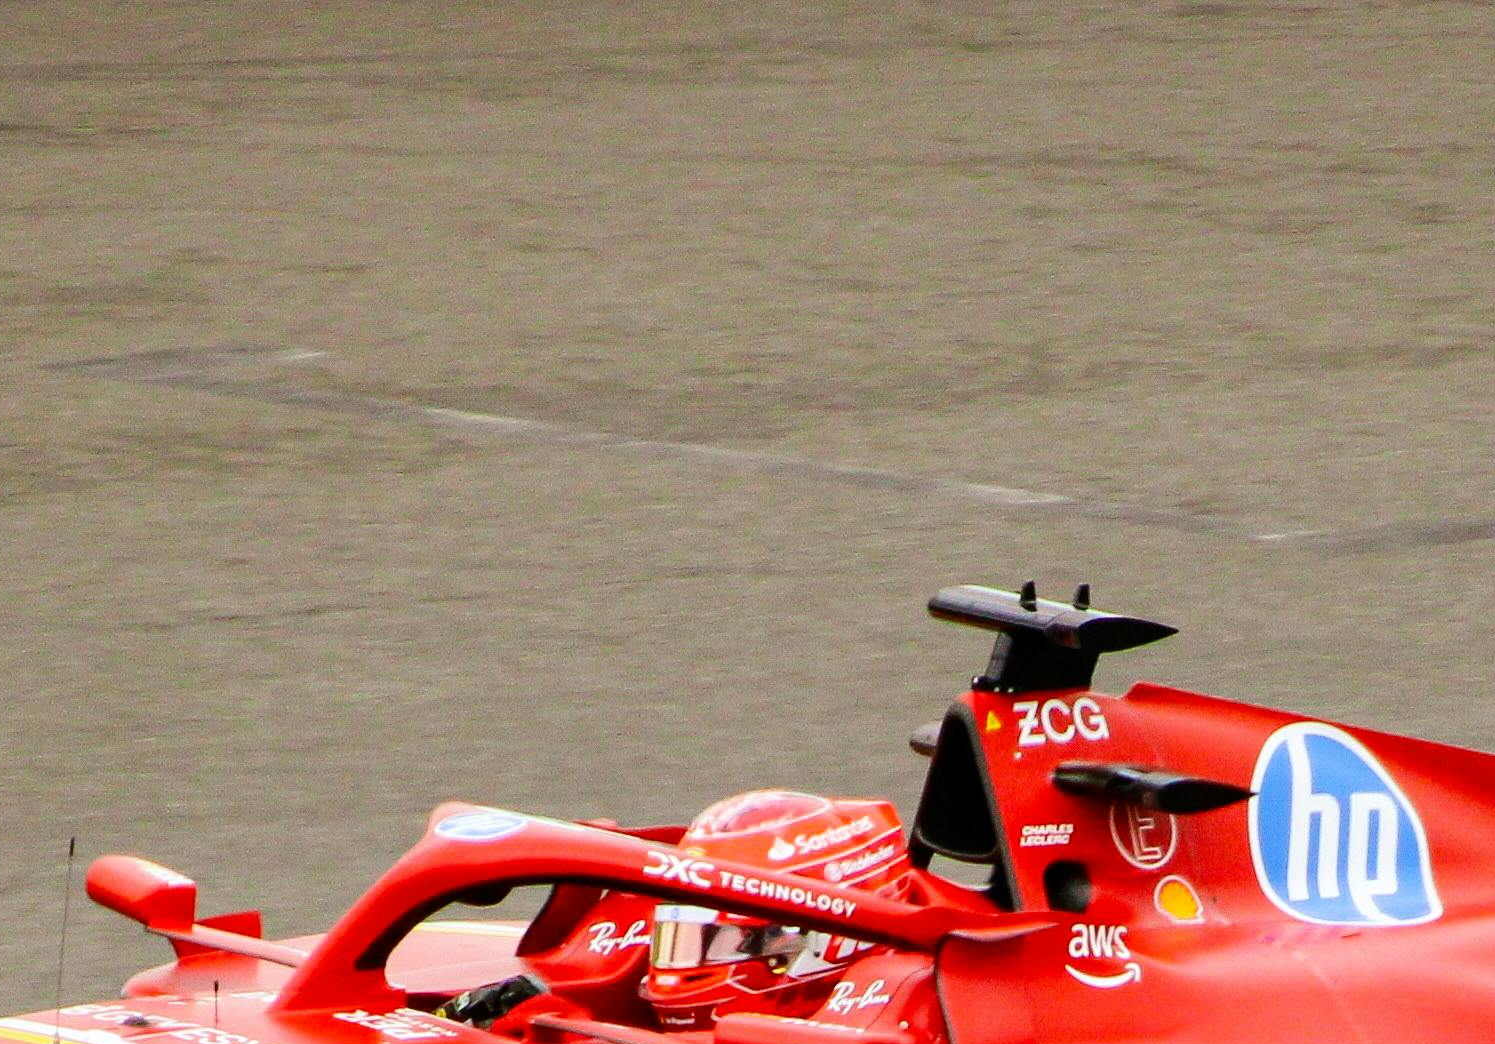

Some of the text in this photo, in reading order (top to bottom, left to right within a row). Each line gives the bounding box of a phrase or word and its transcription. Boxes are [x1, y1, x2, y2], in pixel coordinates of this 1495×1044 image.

[1013, 697, 1109, 746] ZCG
[1020, 834, 1070, 847] LECLERC
[1022, 824, 1074, 837] CHARLES
[1281, 733, 1400, 924] hp
[719, 871, 856, 918] TECHNOLOGY
[1068, 923, 1131, 959] aws
